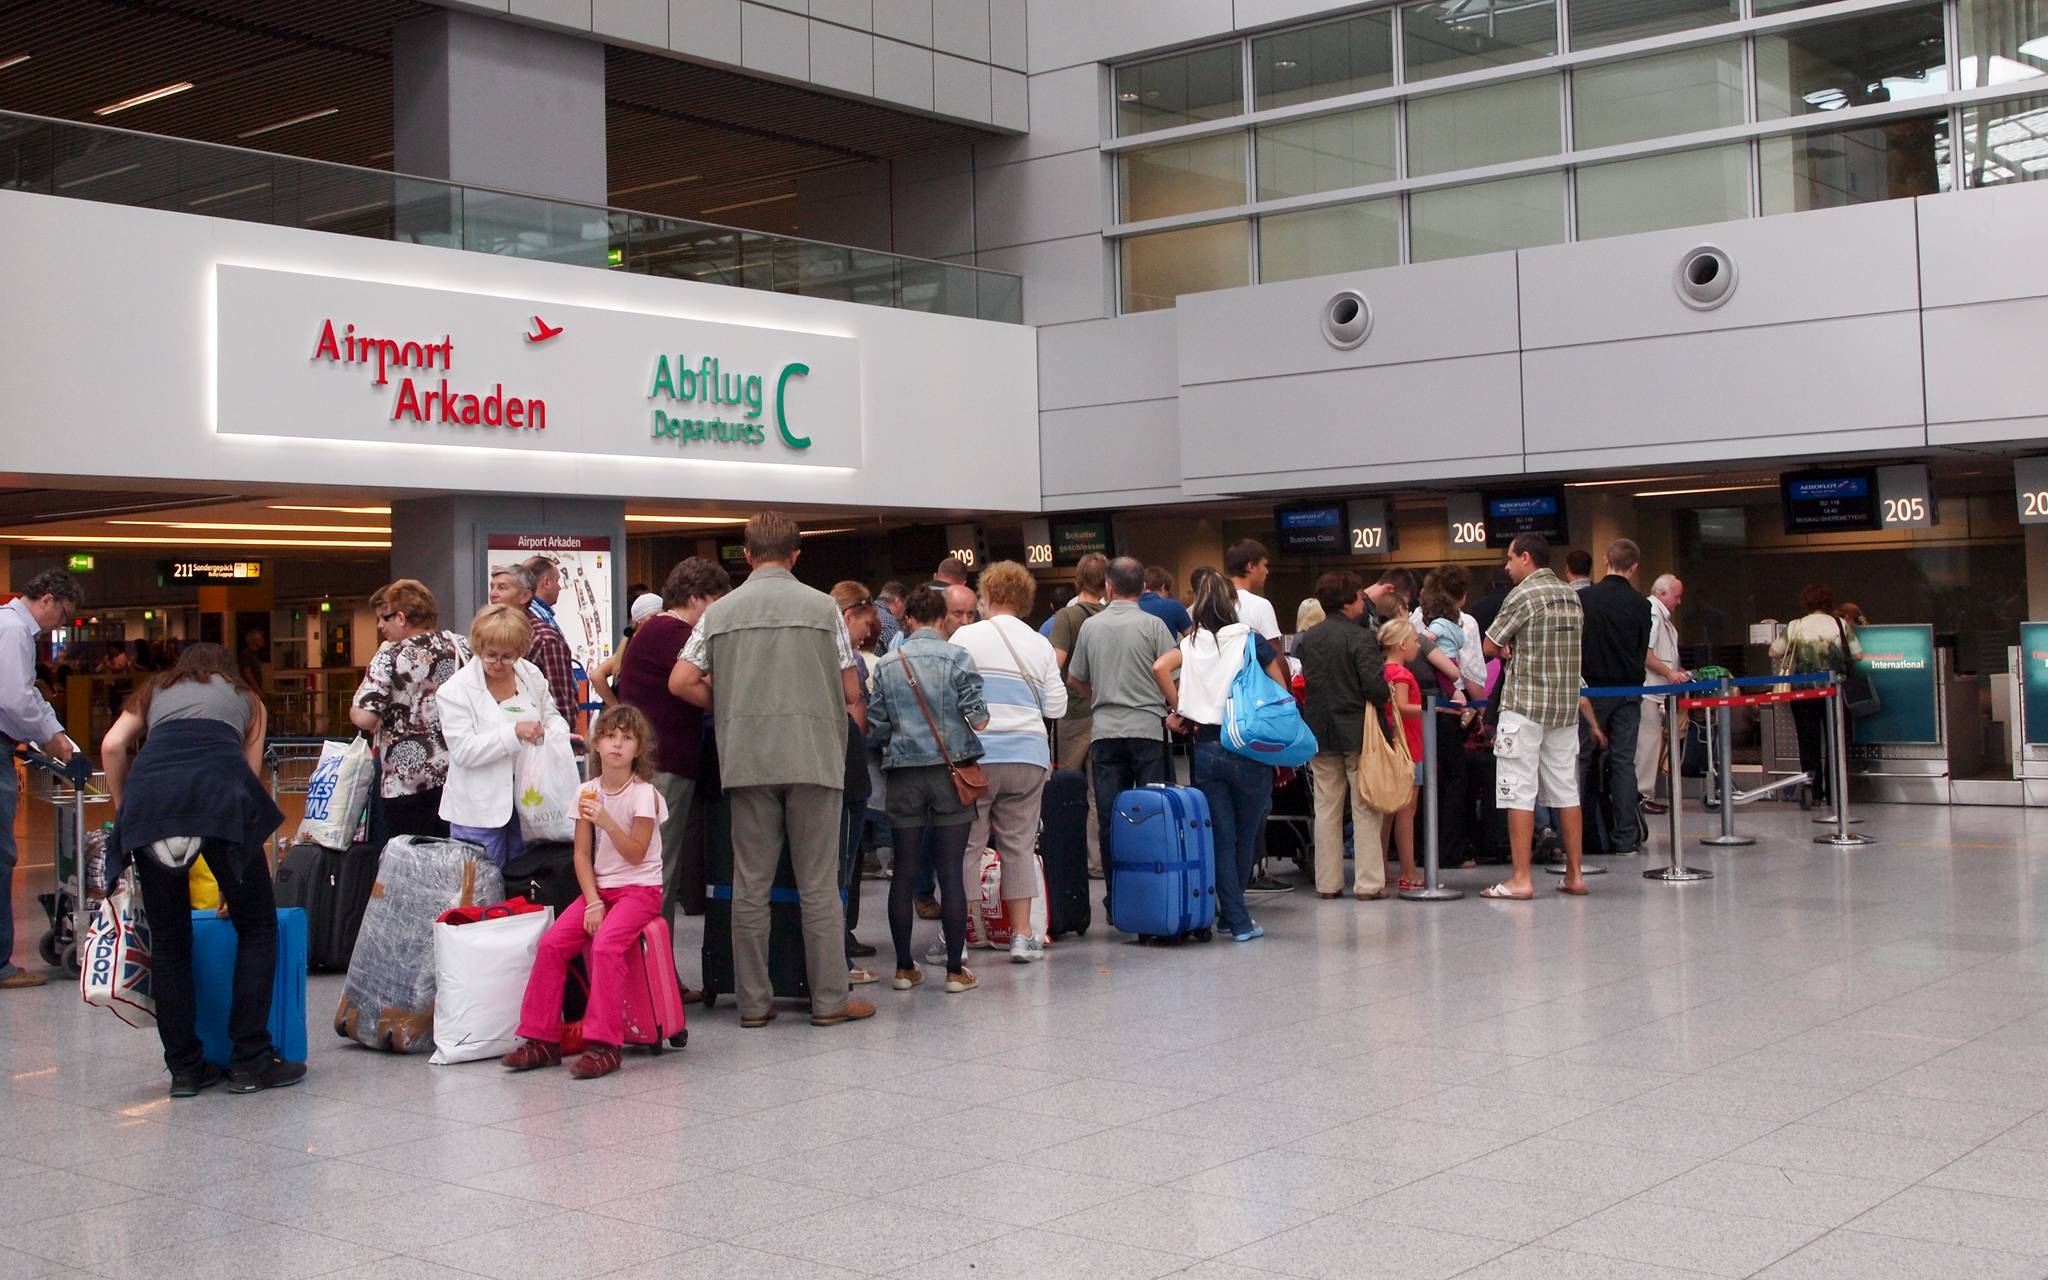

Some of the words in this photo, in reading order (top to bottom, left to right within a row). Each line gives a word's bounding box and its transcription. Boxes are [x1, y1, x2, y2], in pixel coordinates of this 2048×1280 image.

[313, 319, 453, 384] Airport
[650, 354, 762, 417] Abflug
[392, 378, 545, 429] Arkaden
[775, 362, 811, 449] C
[653, 409, 765, 446] Departures
[1883, 498, 1924, 521] 205
[518, 535, 547, 549] Airport
[548, 536, 581, 548] Arkaden
[1352, 527, 1382, 548] 207
[1453, 522, 1485, 543] 206
[1027, 544, 1053, 563] 208
[174, 563, 193, 577] 211
[193, 563, 233, 572] Sondergepäck
[1871, 659, 1924, 669] International
